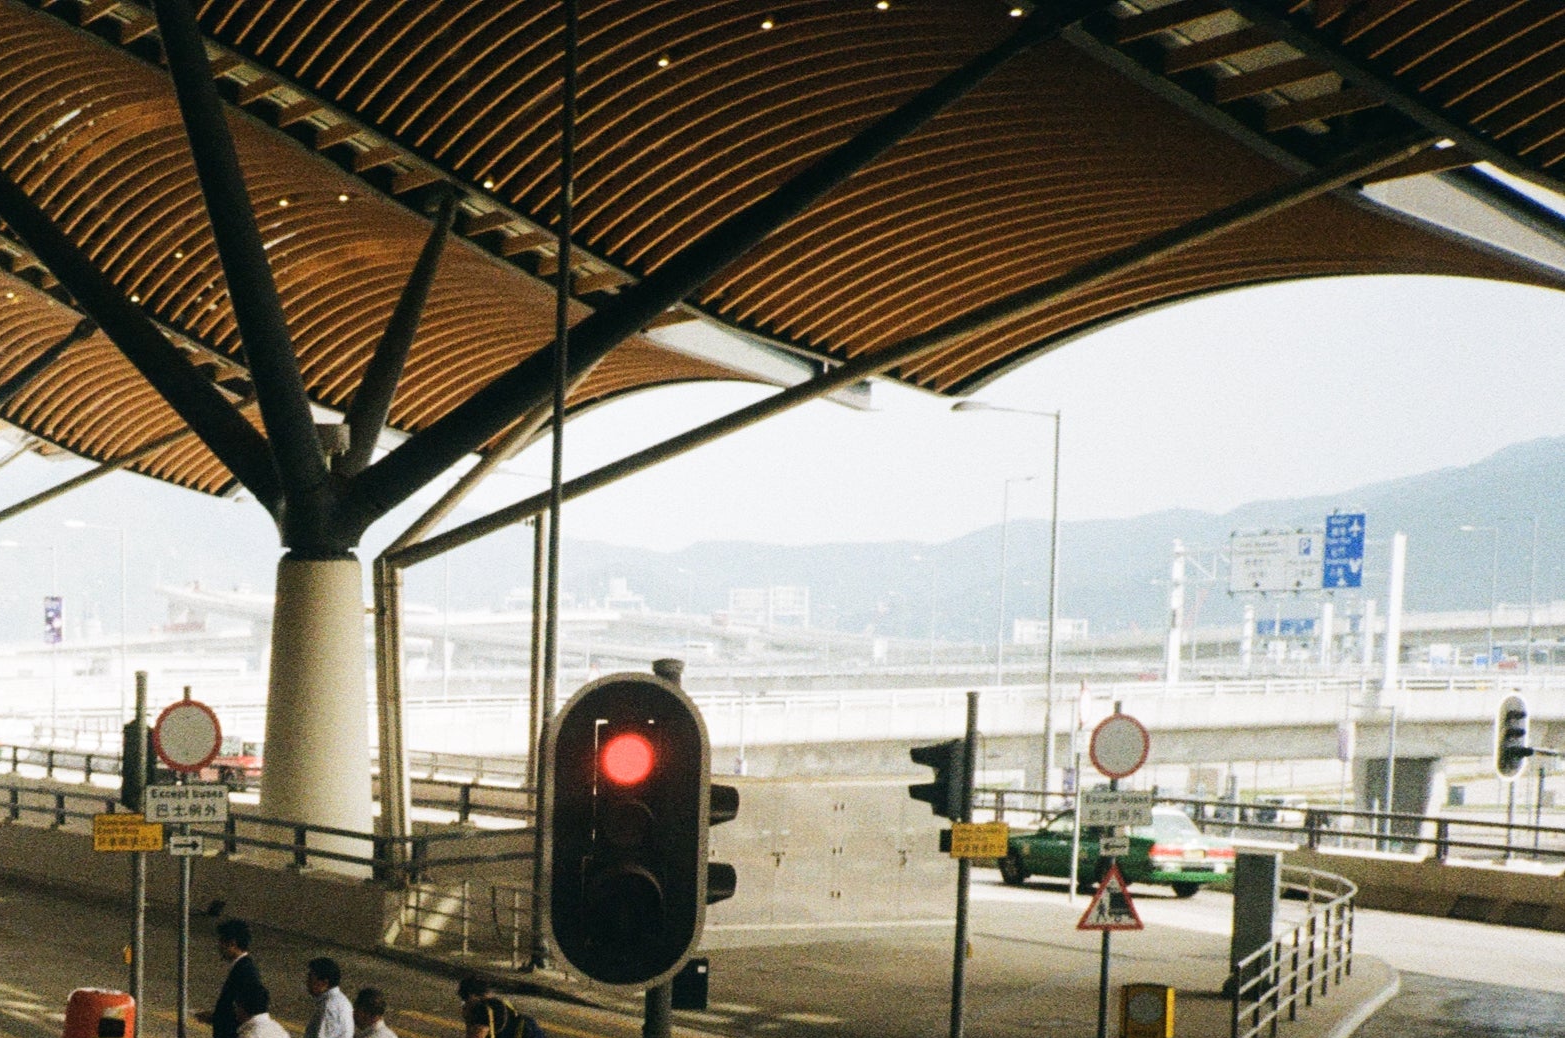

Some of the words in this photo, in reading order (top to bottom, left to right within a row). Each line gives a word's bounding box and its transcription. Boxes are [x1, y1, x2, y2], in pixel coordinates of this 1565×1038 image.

[151, 788, 189, 799] Except
[192, 789, 224, 798] buses
[156, 803, 217, 817] 巴士例外
